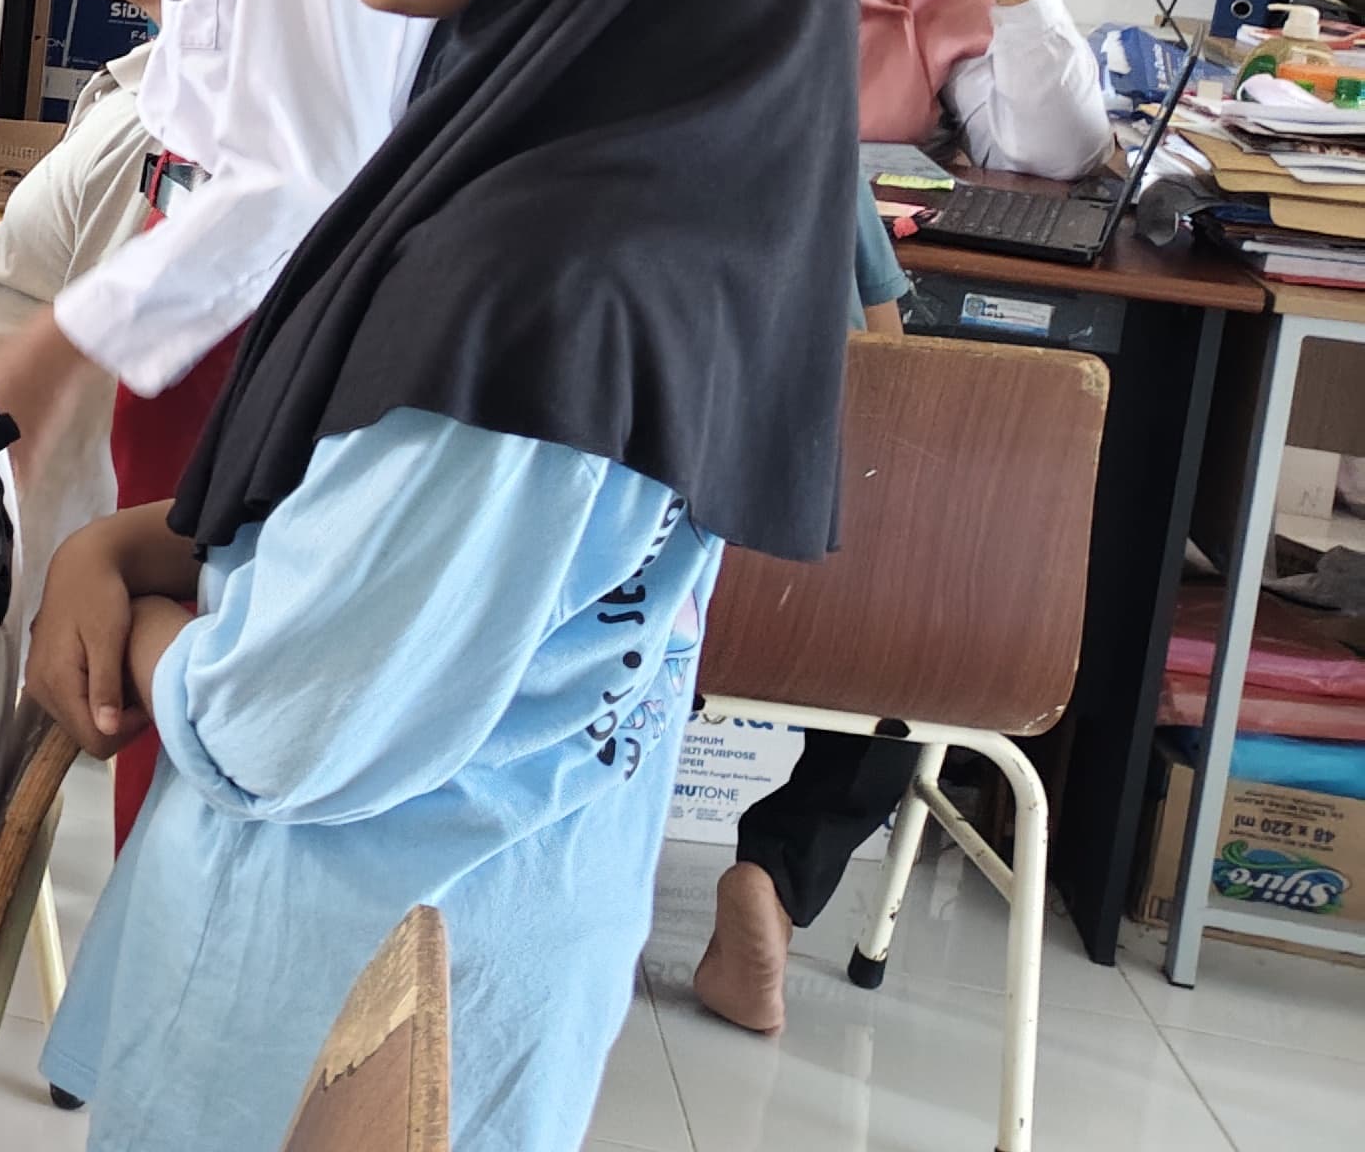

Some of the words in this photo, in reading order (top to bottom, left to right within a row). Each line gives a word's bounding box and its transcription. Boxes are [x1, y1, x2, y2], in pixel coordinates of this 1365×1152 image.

[704, 748, 757, 761] PURPOSE
[674, 784, 740, 801] RUTONE
[1234, 814, 1256, 827] ml
[1260, 817, 1294, 837] 220
